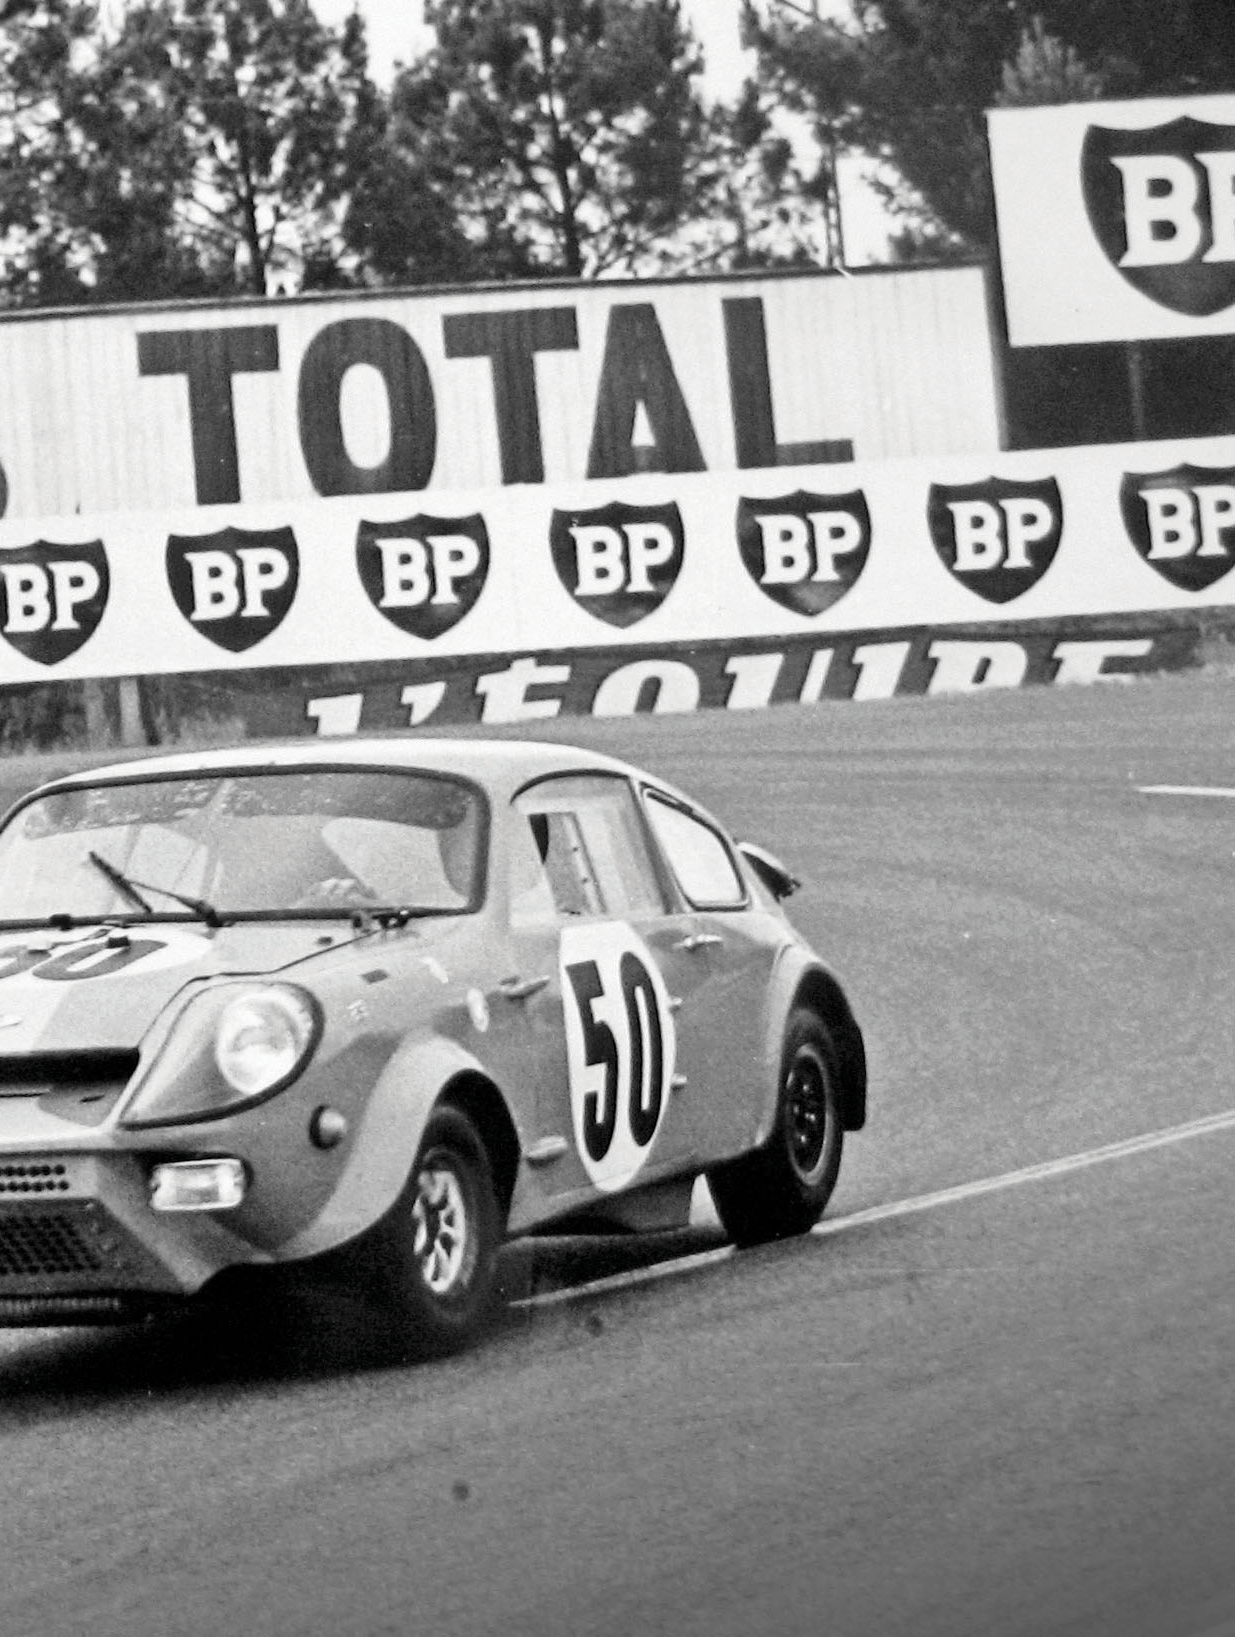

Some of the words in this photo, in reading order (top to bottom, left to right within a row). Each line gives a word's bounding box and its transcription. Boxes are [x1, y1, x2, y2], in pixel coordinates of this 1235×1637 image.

[137, 297, 854, 505] TOTAL
[0, 561, 99, 632] BP
[185, 548, 289, 620] BP
[375, 535, 480, 607] BP
[569, 523, 674, 596] BP
[755, 511, 861, 583] BP
[948, 498, 1053, 571] BP
[1139, 485, 1235, 559] BP
[566, 951, 665, 1164] 50
